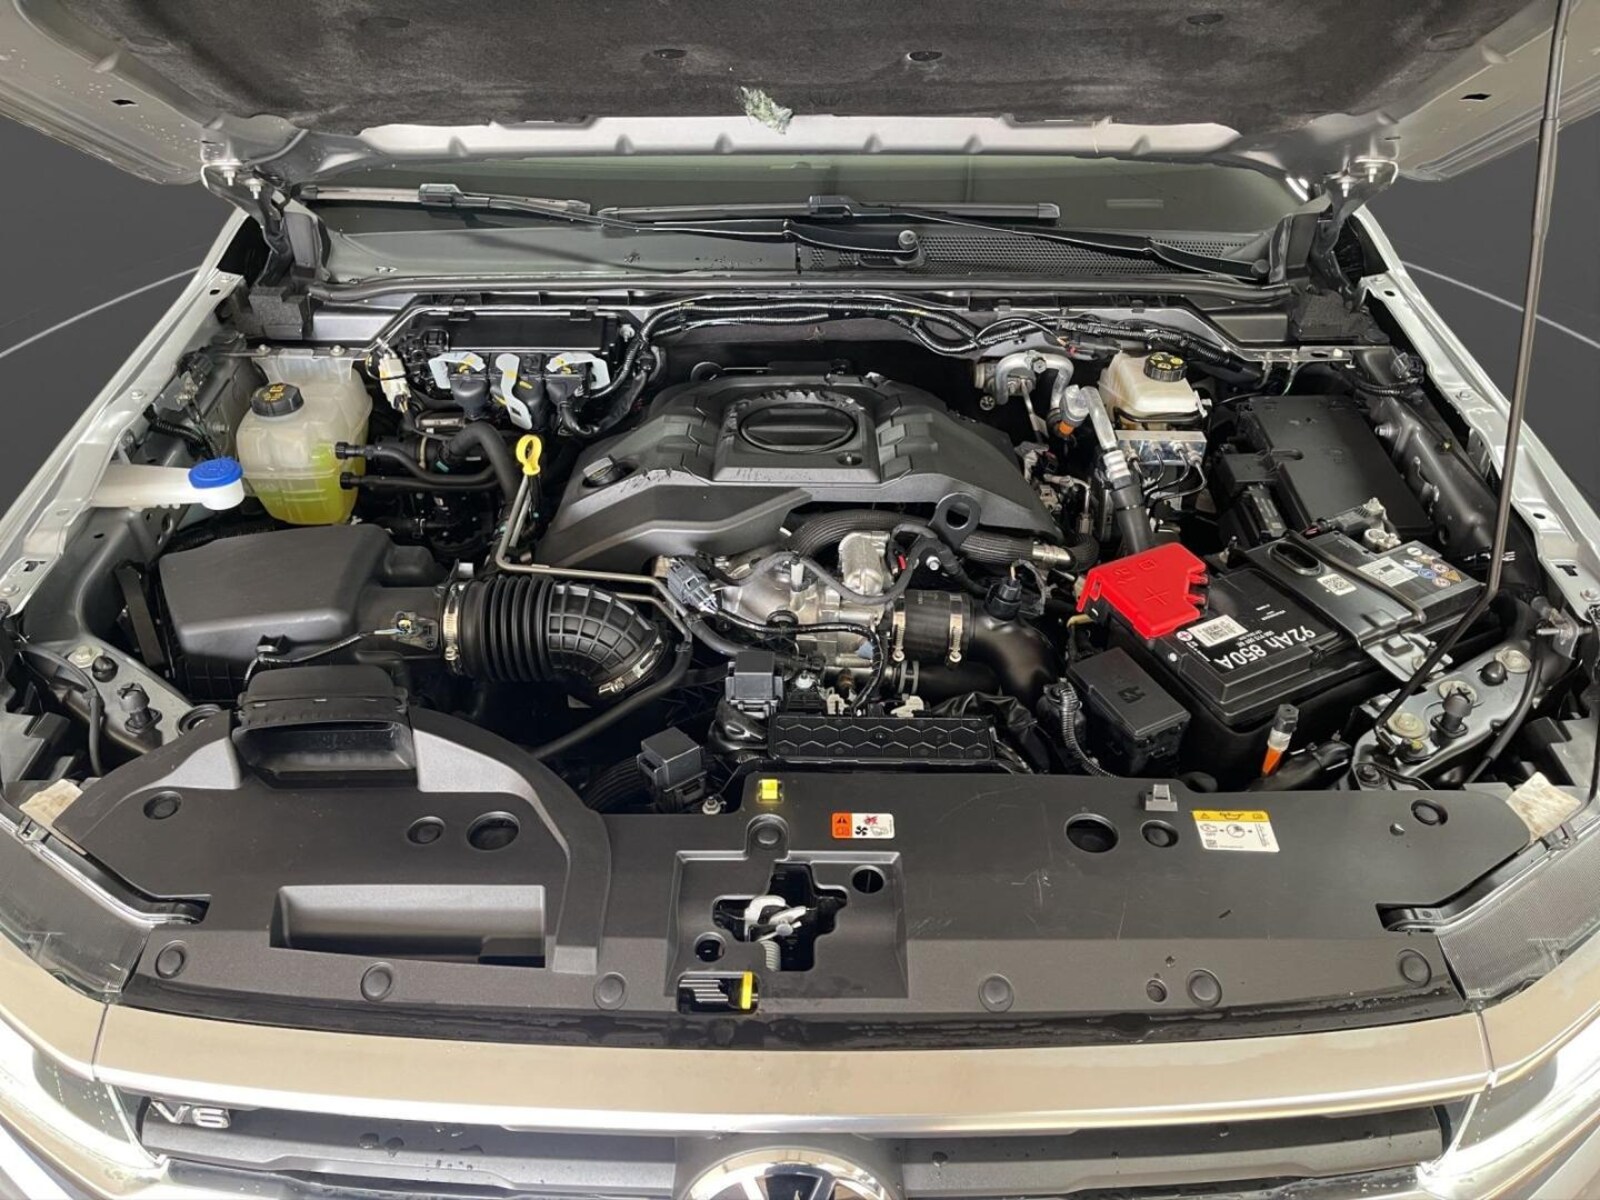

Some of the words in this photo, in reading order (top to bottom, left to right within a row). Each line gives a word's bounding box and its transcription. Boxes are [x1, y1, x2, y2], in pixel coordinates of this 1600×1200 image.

[1265, 625, 1316, 649] 92Ah
[1214, 644, 1267, 669] 850A
[151, 1101, 230, 1129] V6
